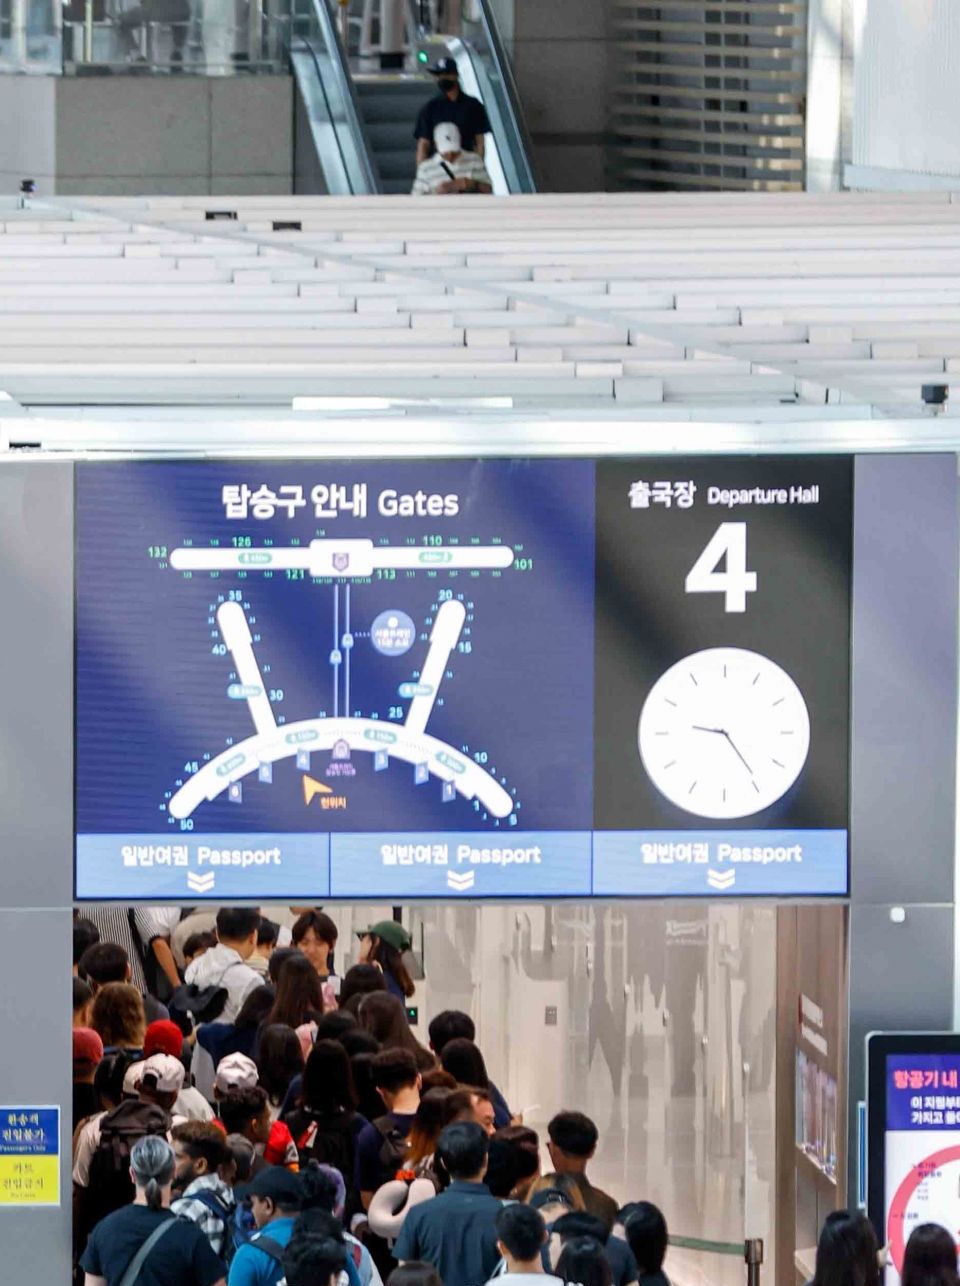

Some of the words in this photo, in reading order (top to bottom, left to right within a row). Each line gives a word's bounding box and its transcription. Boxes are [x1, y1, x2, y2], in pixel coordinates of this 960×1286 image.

[221, 482, 306, 519] 탑승구
[311, 482, 367, 519] 안내
[377, 489, 459, 517] Gates
[628, 480, 697, 508] 출국장
[707, 486, 788, 509] Departure
[790, 485, 820, 504] Hall
[232, 537, 252, 548] 126
[423, 535, 443, 546] 110
[148, 547, 168, 559] 132
[514, 558, 533, 570] 101
[685, 521, 758, 613] 4
[286, 569, 305, 580] 121
[377, 568, 396, 580] 113
[438, 589, 453, 600] 20
[212, 644, 227, 656] 40
[459, 641, 472, 653] 15
[270, 689, 284, 701] 30
[474, 752, 488, 763] 10
[185, 761, 198, 773] 45
[180, 818, 194, 831] 50
[121, 846, 189, 867] 일반여권
[197, 846, 282, 868] Passport
[381, 844, 449, 865] 일반여권
[457, 844, 542, 866] Passport
[641, 843, 709, 864] 일반여권
[717, 843, 802, 865] Passport
[893, 1069, 939, 1089] 항공기
[941, 1069, 959, 1089] 내
[910, 1095, 923, 1110] 이
[911, 1110, 944, 1125] 가지고
